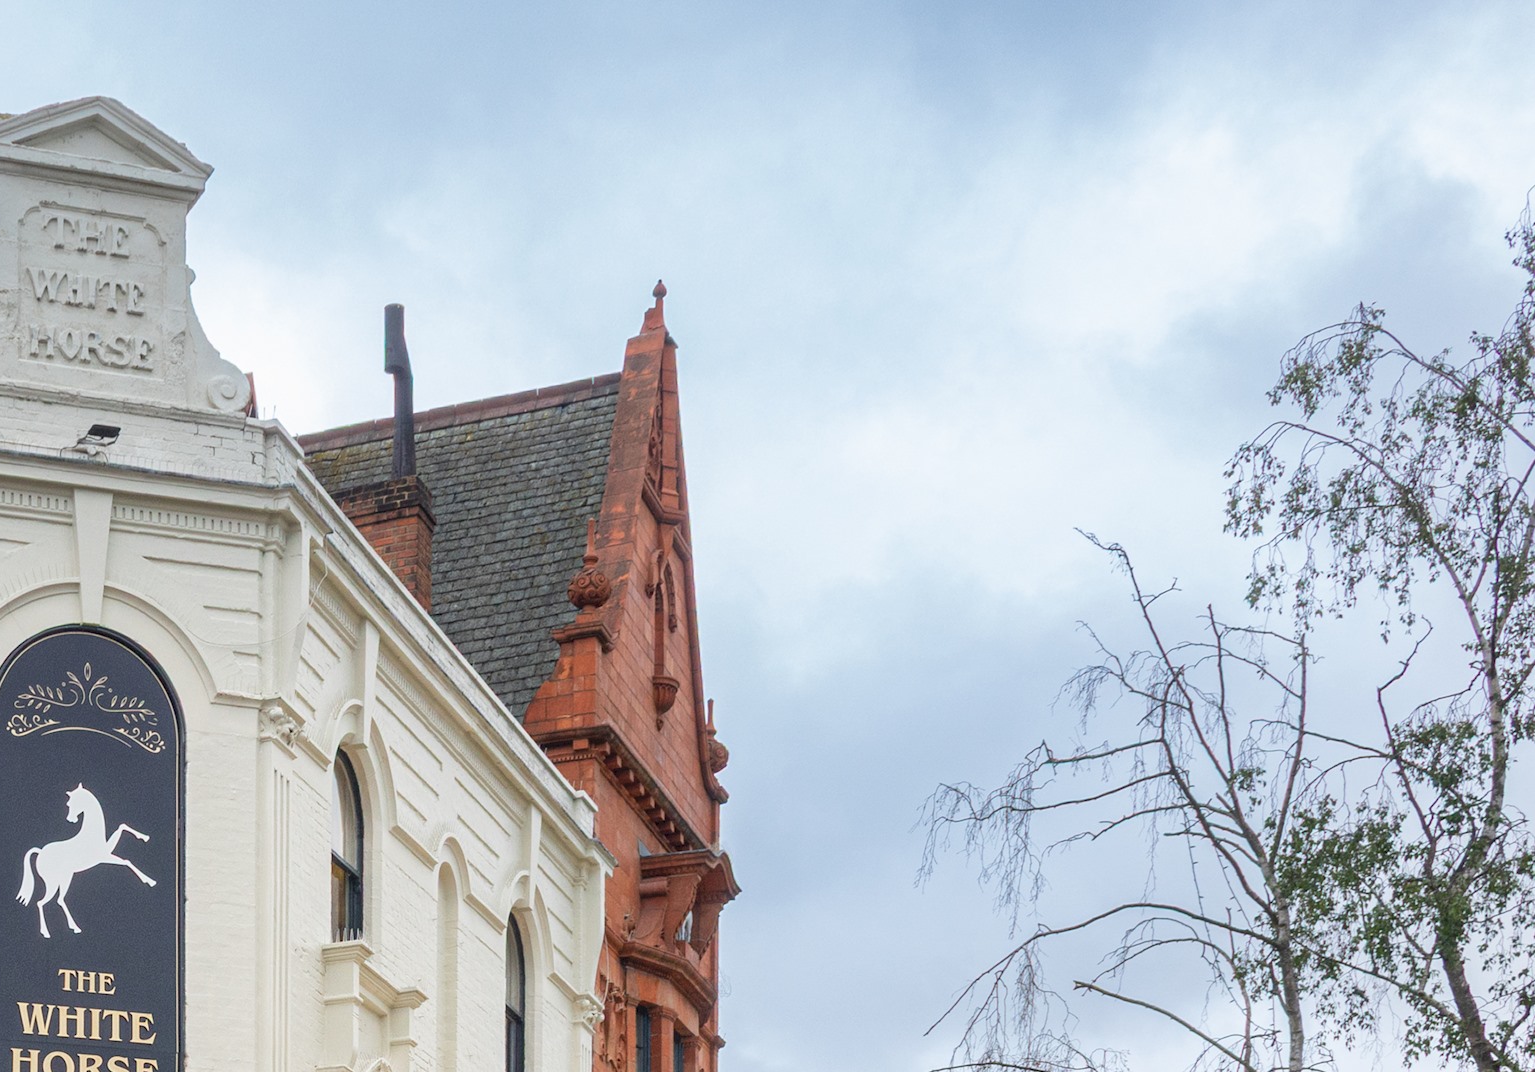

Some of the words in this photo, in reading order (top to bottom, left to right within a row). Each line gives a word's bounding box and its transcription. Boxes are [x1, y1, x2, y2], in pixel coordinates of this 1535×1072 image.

[42, 214, 131, 259] THE
[25, 267, 146, 316] WHITE
[28, 323, 156, 372] HORSE
[57, 968, 116, 995] THE
[16, 1001, 157, 1045] WHITE
